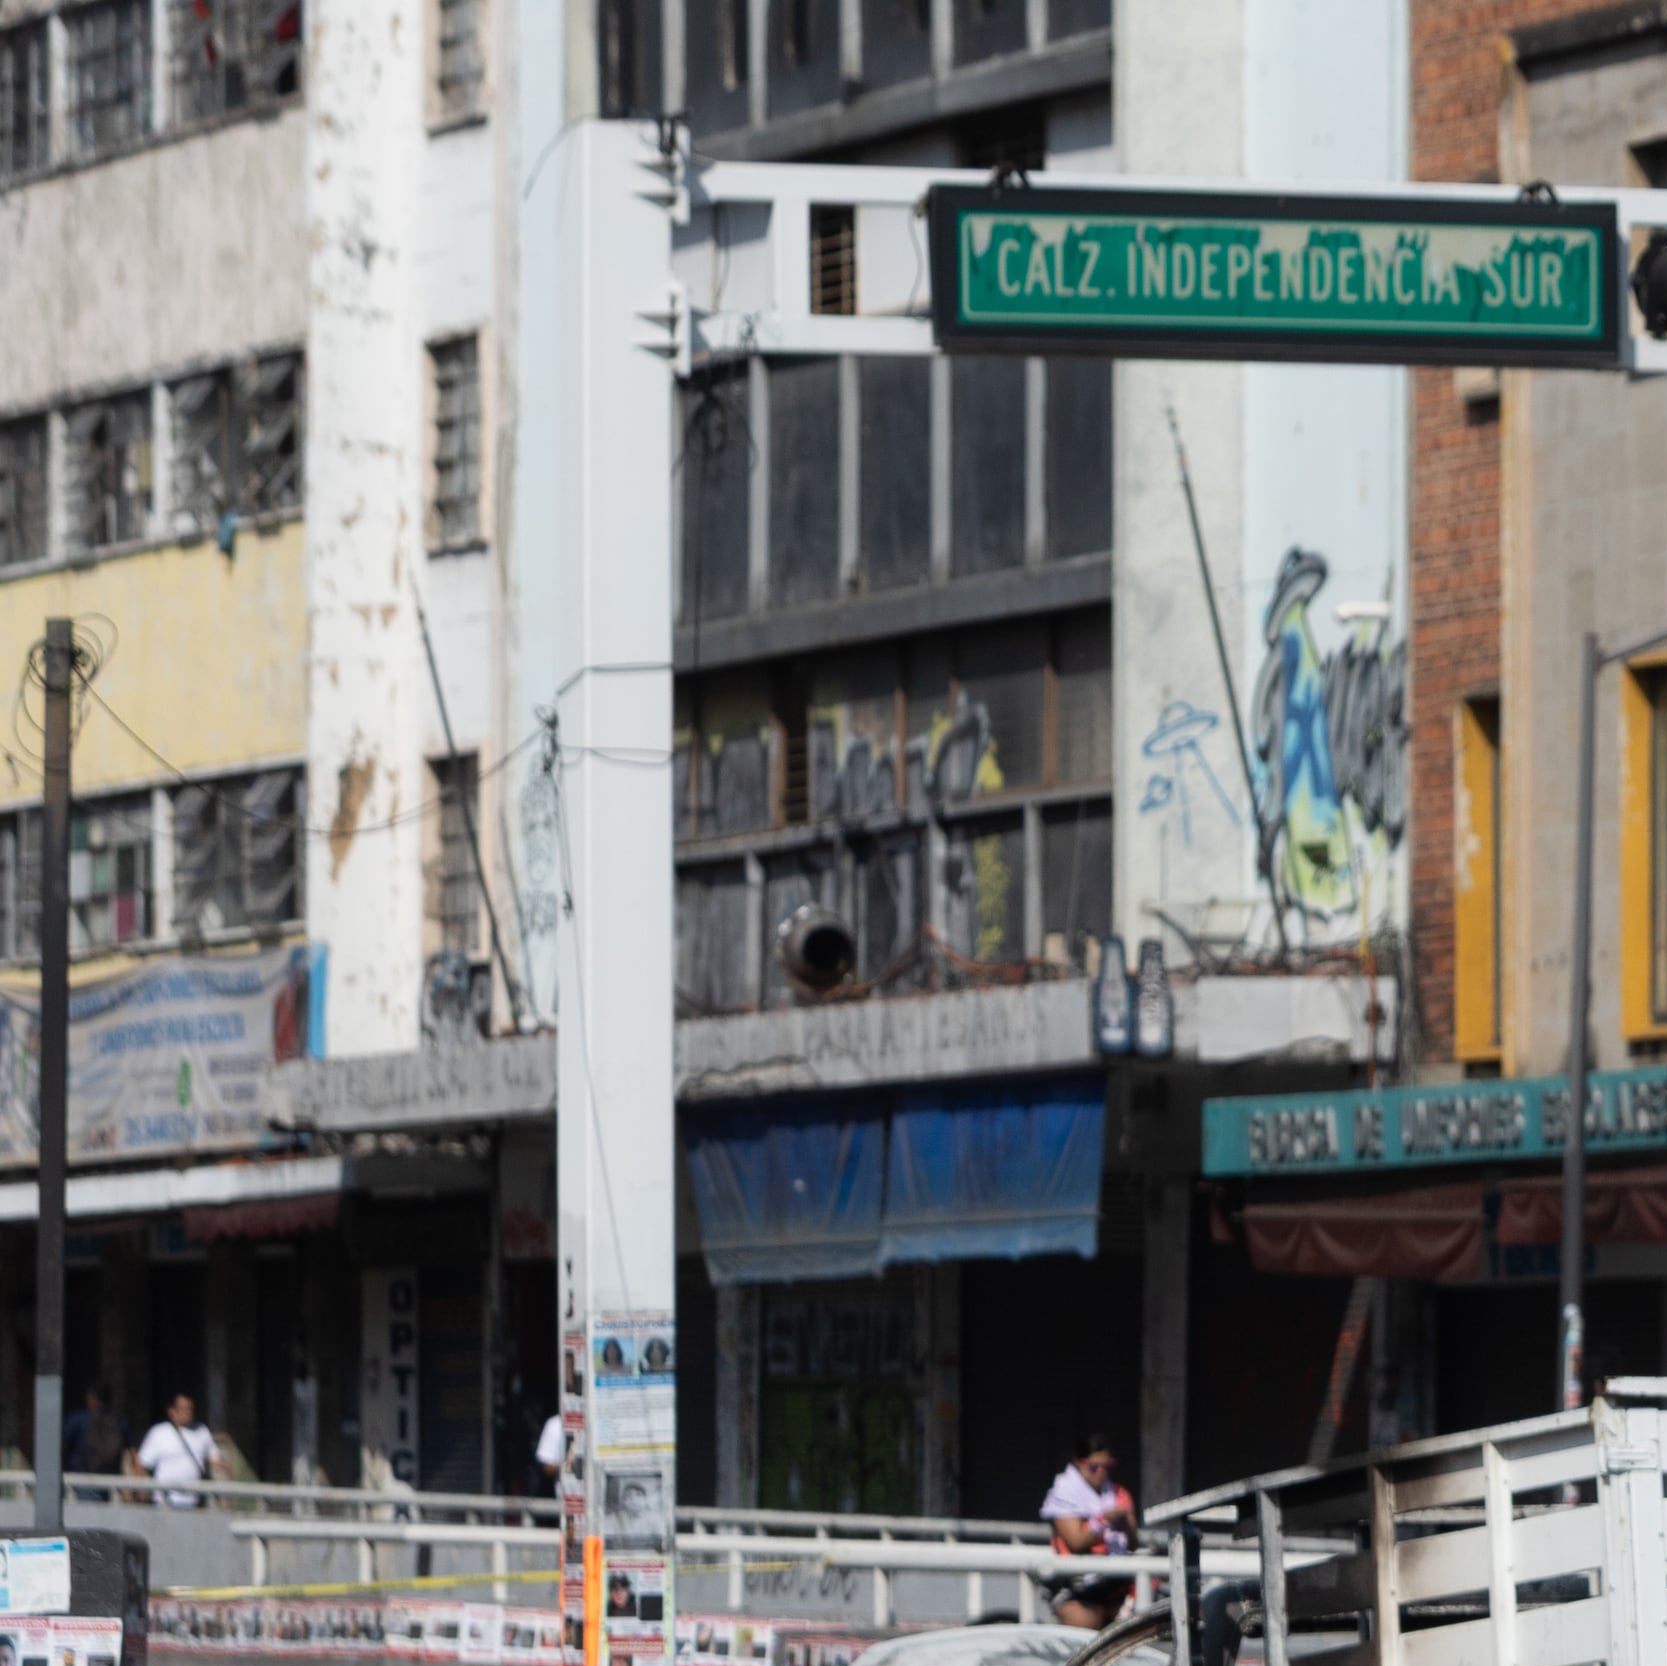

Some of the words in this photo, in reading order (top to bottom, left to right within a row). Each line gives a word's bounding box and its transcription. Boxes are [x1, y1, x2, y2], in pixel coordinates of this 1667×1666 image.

[998, 237, 1116, 298] CALZ.
[1128, 241, 1461, 306] INDEPENDENCIA
[1482, 250, 1563, 308] SUR
